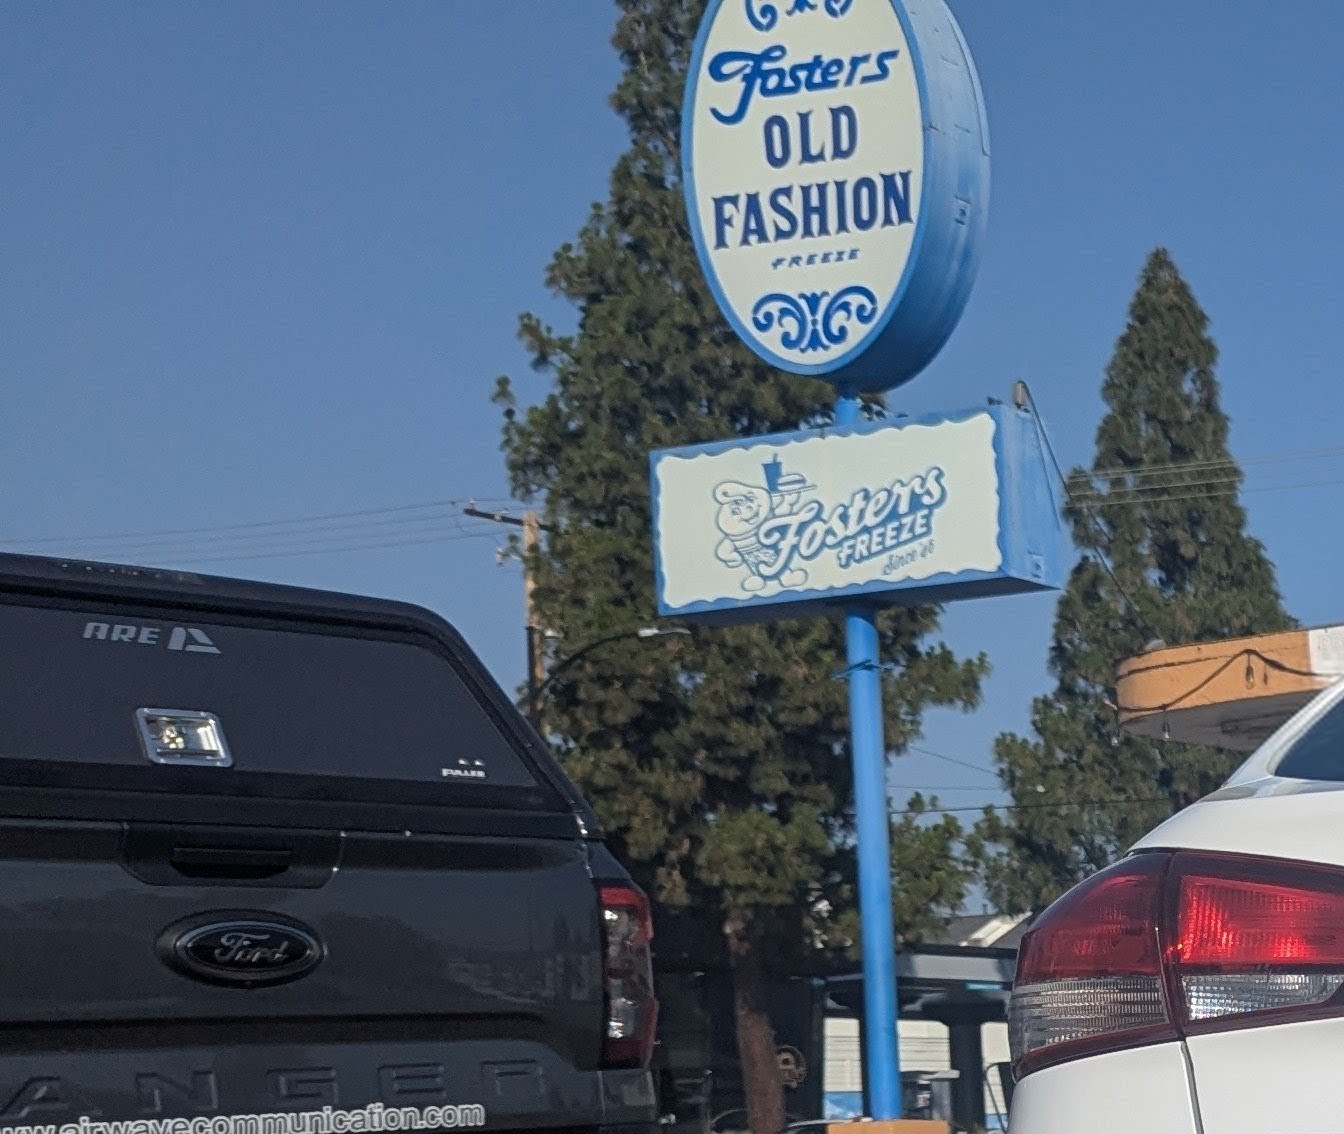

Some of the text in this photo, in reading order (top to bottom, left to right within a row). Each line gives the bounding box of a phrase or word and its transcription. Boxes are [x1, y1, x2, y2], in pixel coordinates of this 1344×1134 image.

[709, 45, 899, 125] Fosters
[763, 105, 858, 169] OLD
[711, 170, 914, 250] FASHION
[771, 249, 860, 270] FREEZE
[758, 467, 947, 579] Fosters
[838, 508, 933, 569] FREEZE
[82, 622, 161, 645] ARE
[214, 932, 290, 963] Ford
